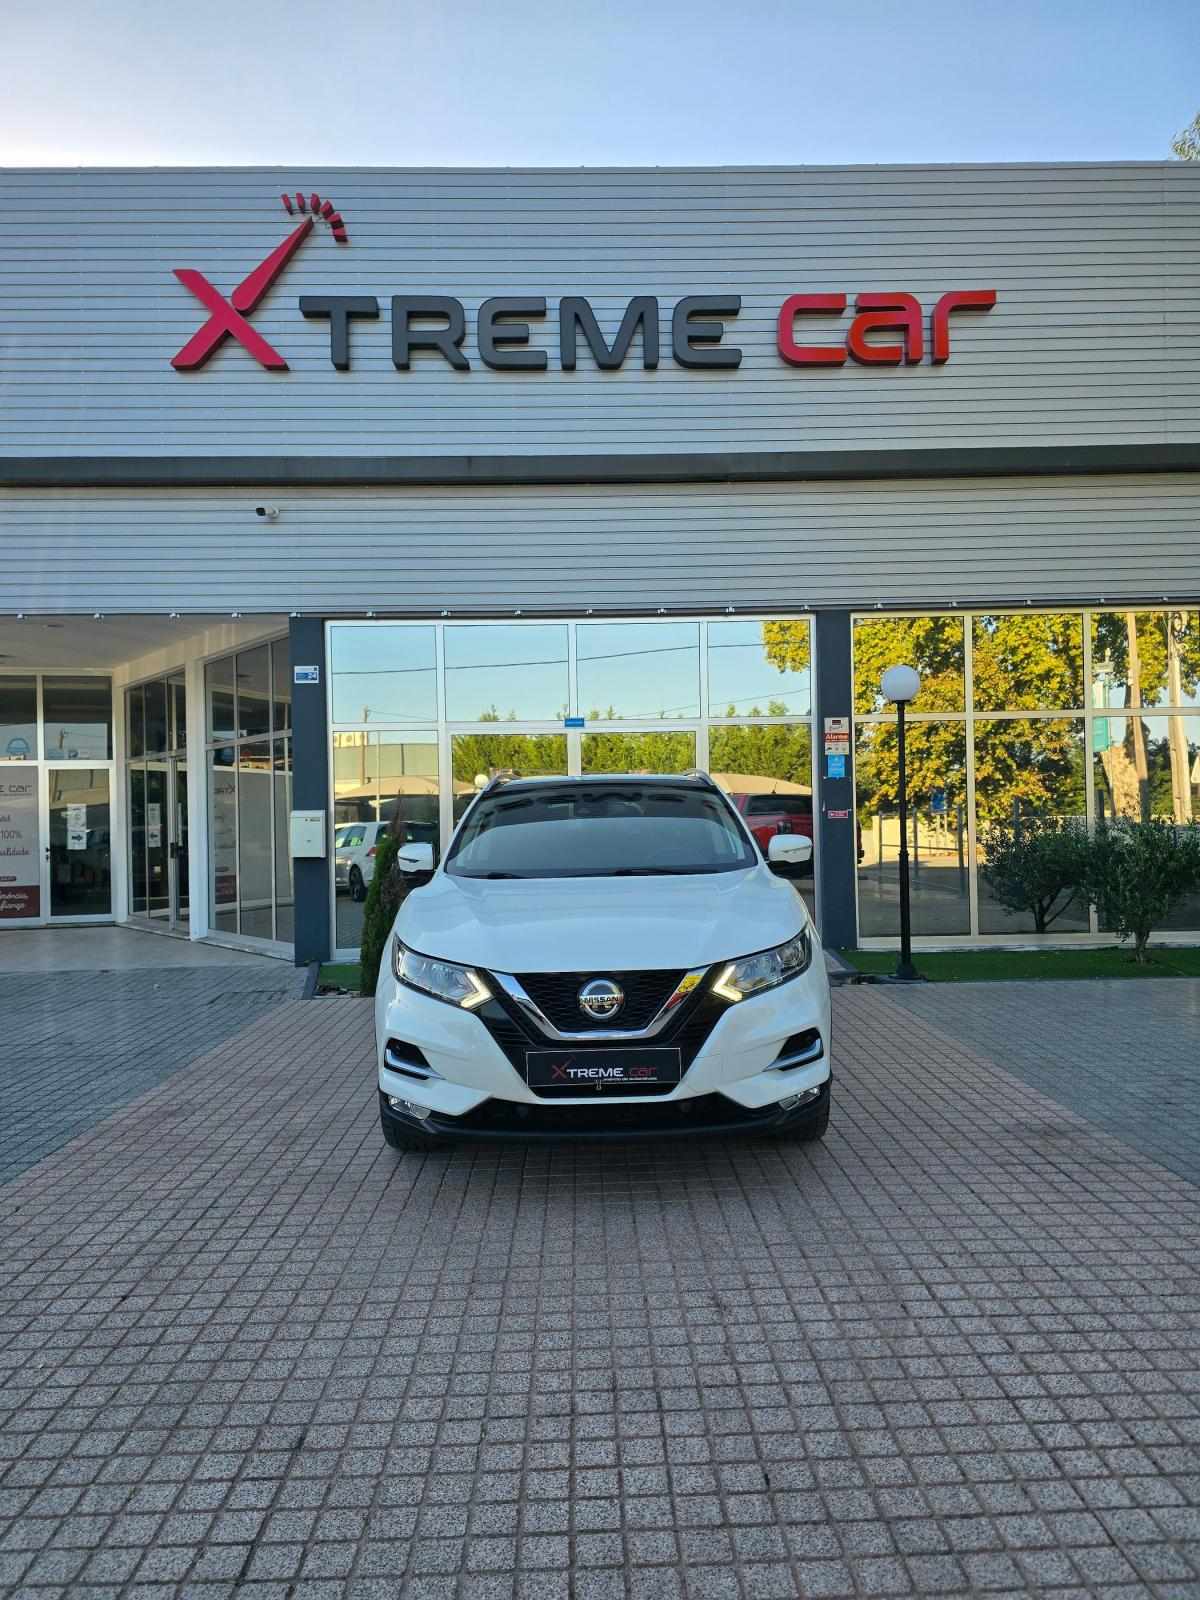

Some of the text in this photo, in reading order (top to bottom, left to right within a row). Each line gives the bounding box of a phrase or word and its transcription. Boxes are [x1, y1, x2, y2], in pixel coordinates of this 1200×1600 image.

[169, 214, 997, 371] XTREME car
[582, 995, 620, 1003] NISSAN
[551, 1059, 657, 1080] XTREME car
